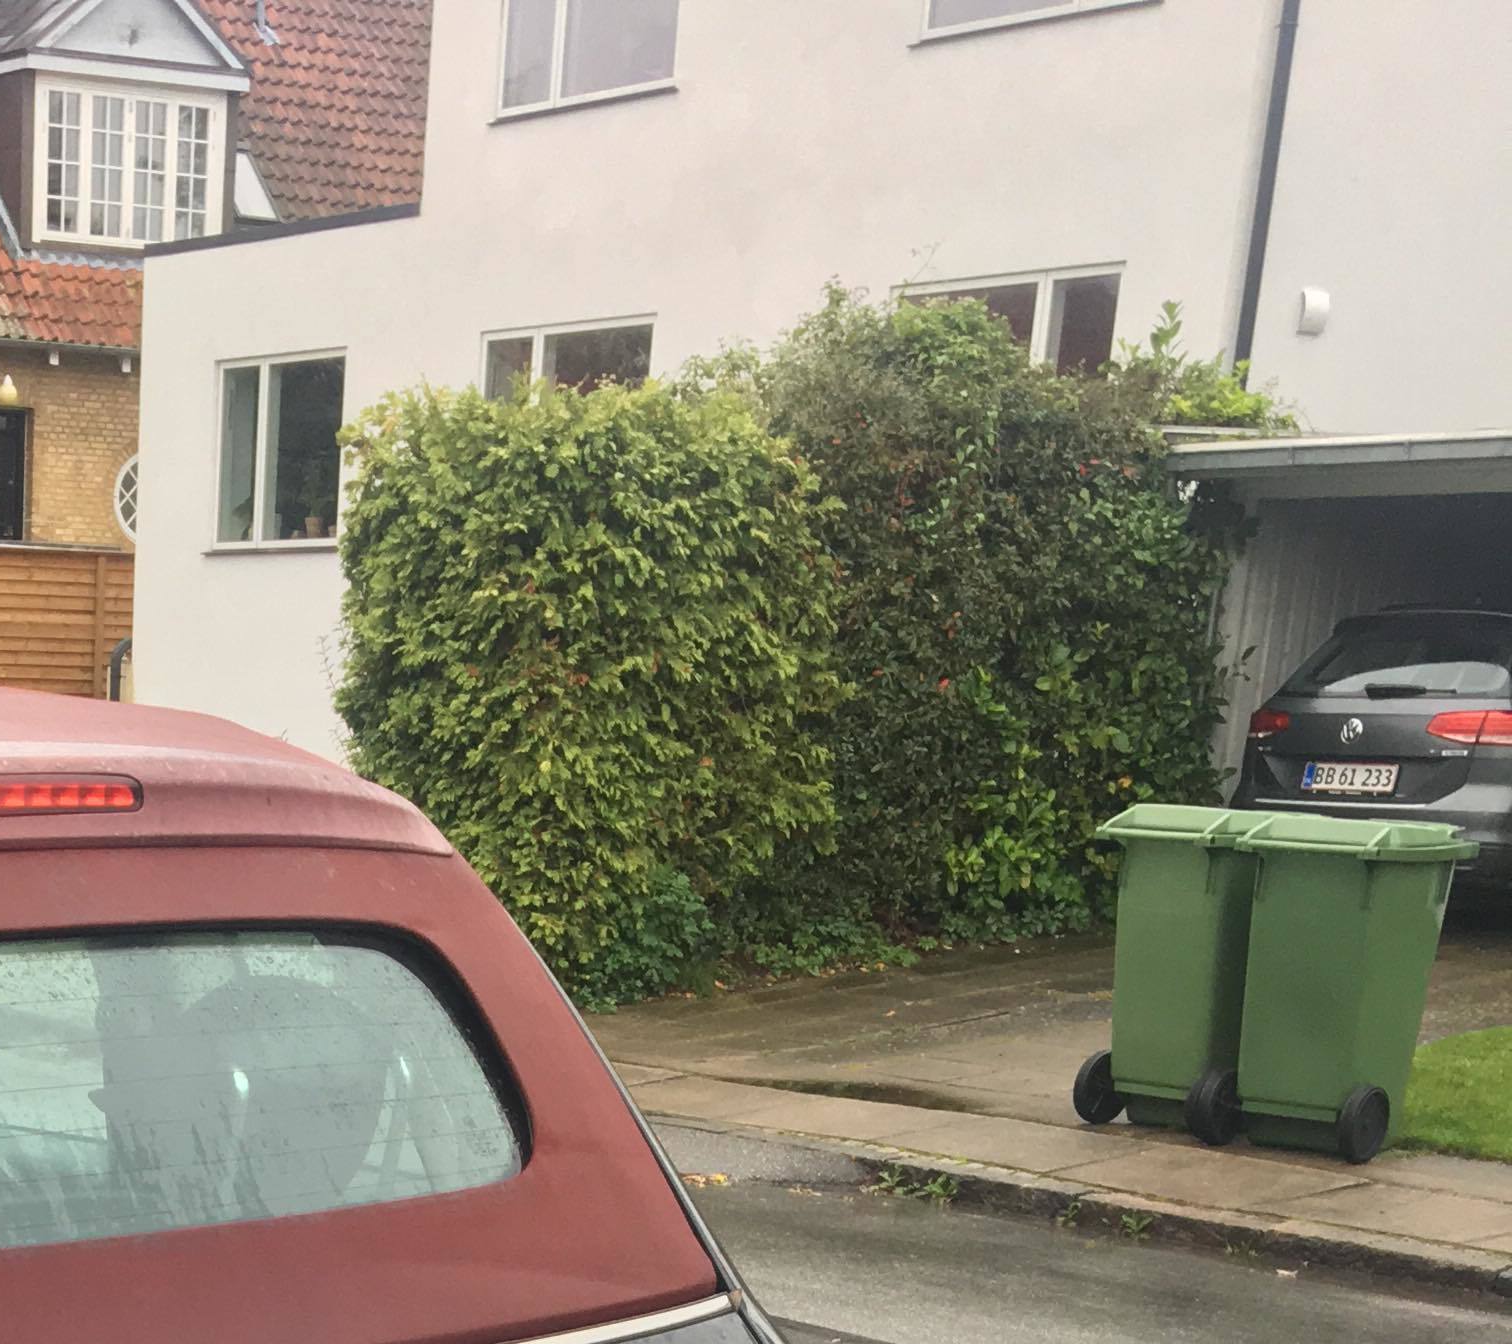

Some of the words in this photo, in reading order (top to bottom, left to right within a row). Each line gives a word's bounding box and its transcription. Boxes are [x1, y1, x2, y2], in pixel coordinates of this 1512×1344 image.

[1313, 767, 1336, 784] BB
[1338, 768, 1356, 786] 61
[1361, 769, 1393, 787] 233
